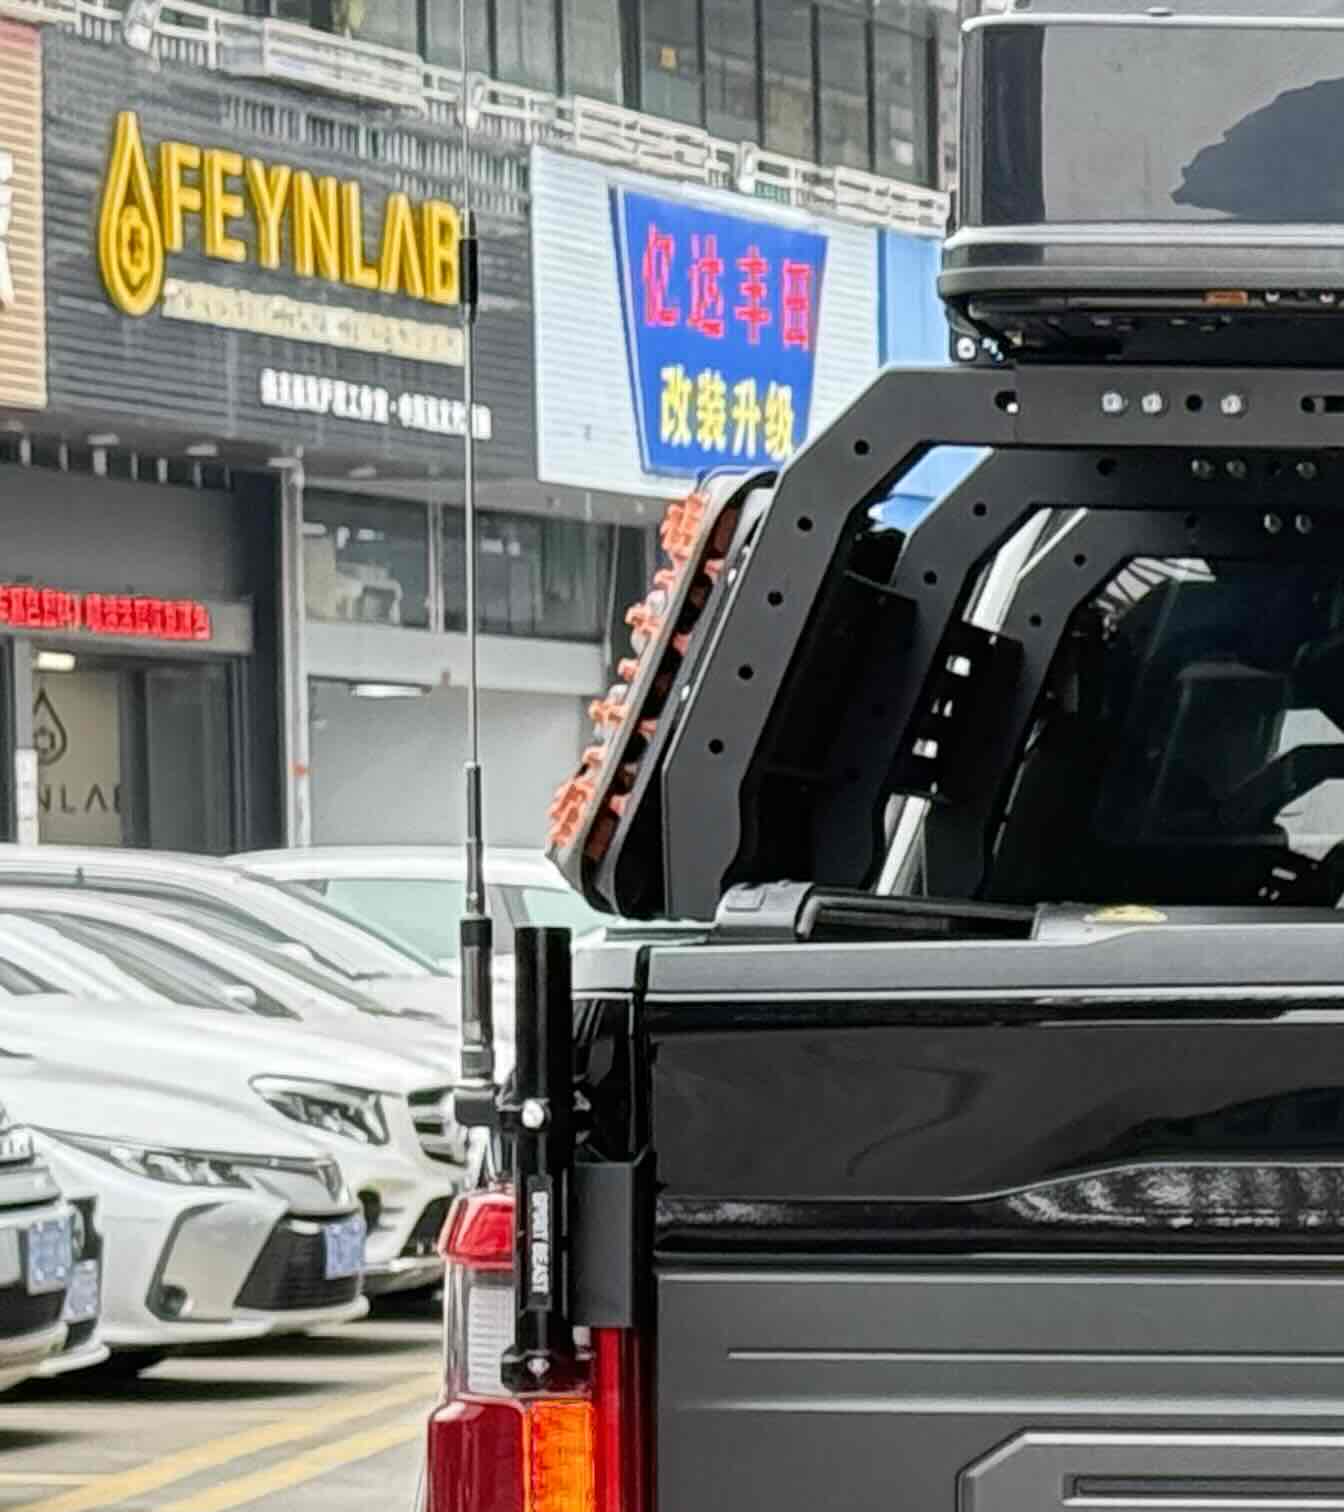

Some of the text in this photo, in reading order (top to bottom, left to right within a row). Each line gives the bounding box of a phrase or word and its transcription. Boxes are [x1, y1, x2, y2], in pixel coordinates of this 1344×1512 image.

[160, 141, 460, 306] FEYNLAB
[641, 222, 812, 350] 亿达丰田
[660, 363, 795, 461] 改装升级
